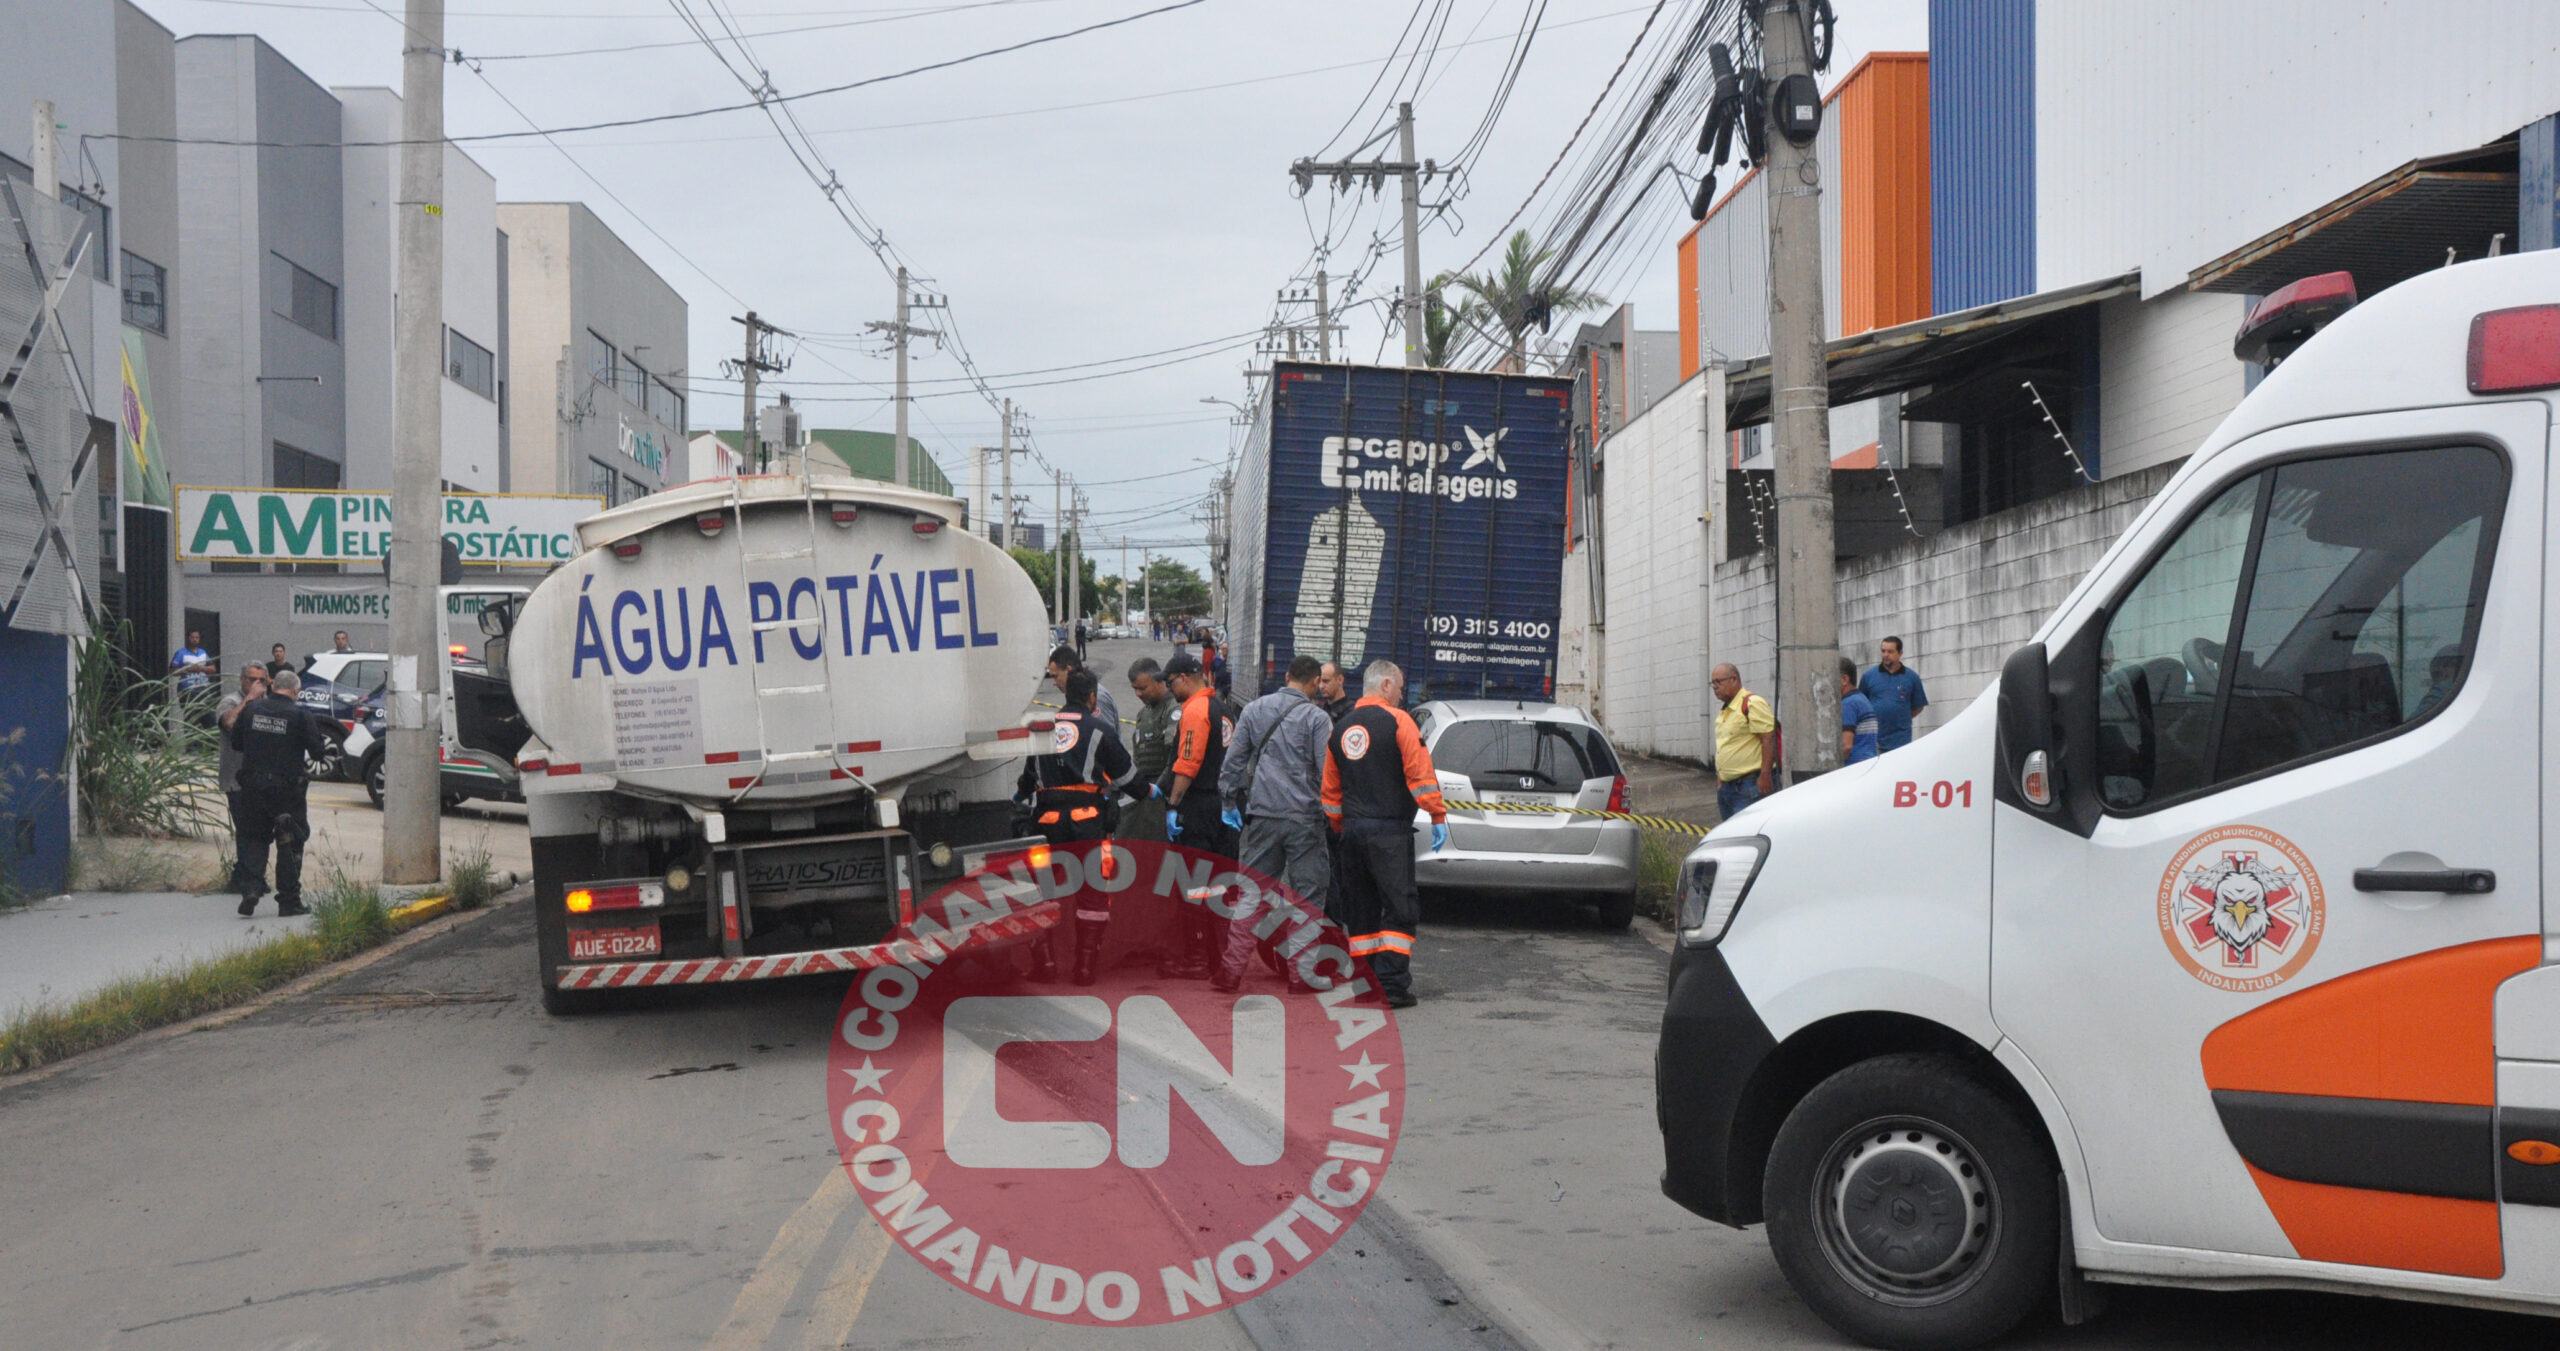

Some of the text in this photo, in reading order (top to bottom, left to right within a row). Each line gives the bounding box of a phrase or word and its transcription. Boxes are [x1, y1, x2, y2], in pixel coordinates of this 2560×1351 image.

[619, 412, 663, 475] bioactive
[190, 493, 337, 556] AM
[342, 497, 490, 524] PINRA
[294, 594, 360, 614] PINTAMOS
[572, 554, 998, 679] ÁGUA POTÁVEL
[1464, 618, 1499, 636] 3115
[1504, 621, 1551, 639] 4100
[1893, 780, 1972, 808] B-01
[2160, 828, 2323, 936] SERVIÇO DE ATENDIMENTO MUNICIPAL DE EMERGÊNCIA SAME
[2197, 969, 2285, 991] INDAIATUBA
